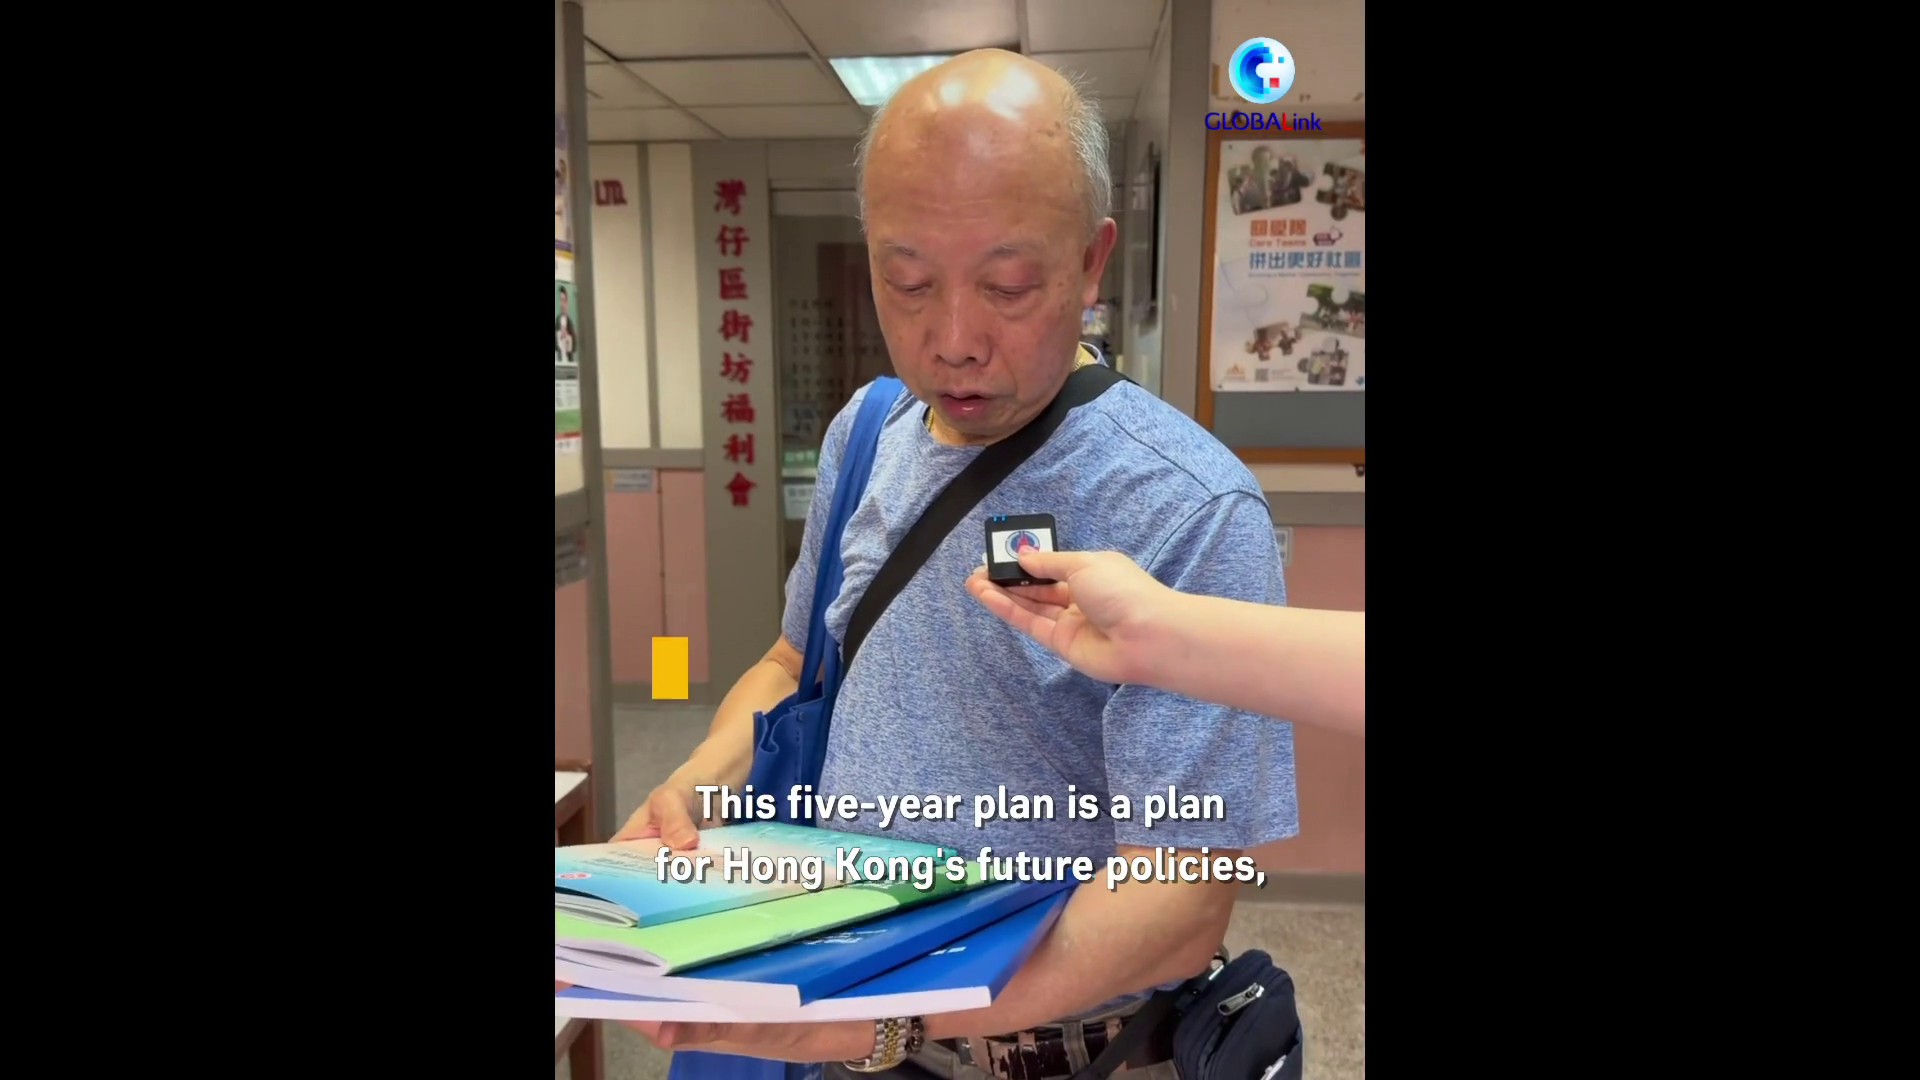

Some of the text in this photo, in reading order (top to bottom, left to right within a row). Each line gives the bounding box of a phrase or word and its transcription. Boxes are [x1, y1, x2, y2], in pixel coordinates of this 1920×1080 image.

[714, 179, 757, 508] 灣仔區街坊福利會
